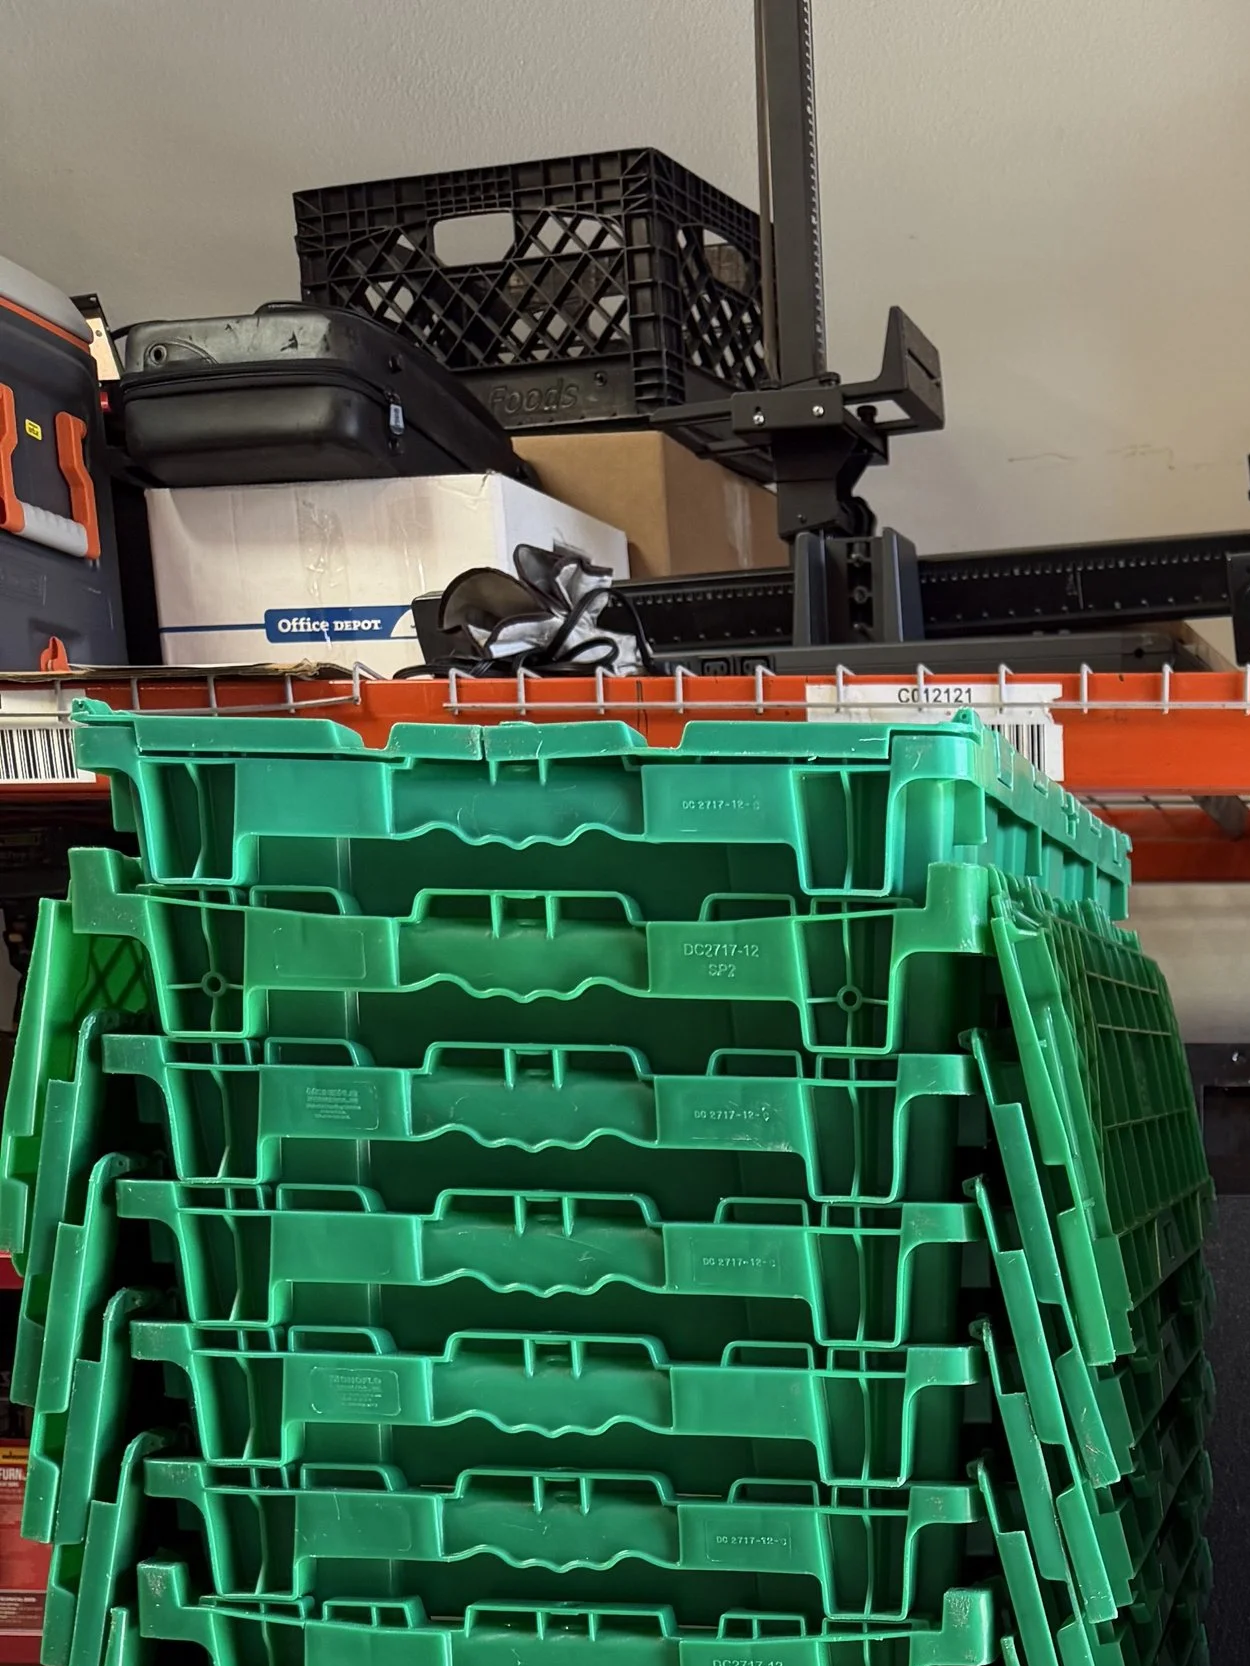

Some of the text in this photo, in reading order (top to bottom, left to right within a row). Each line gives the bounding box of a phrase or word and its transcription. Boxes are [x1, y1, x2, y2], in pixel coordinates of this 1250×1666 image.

[489, 377, 580, 414] Foods
[277, 617, 382, 633] Office DEPOT
[898, 688, 972, 703] C012121
[683, 942, 760, 958] DC2717-12
[708, 963, 737, 978] SP2
